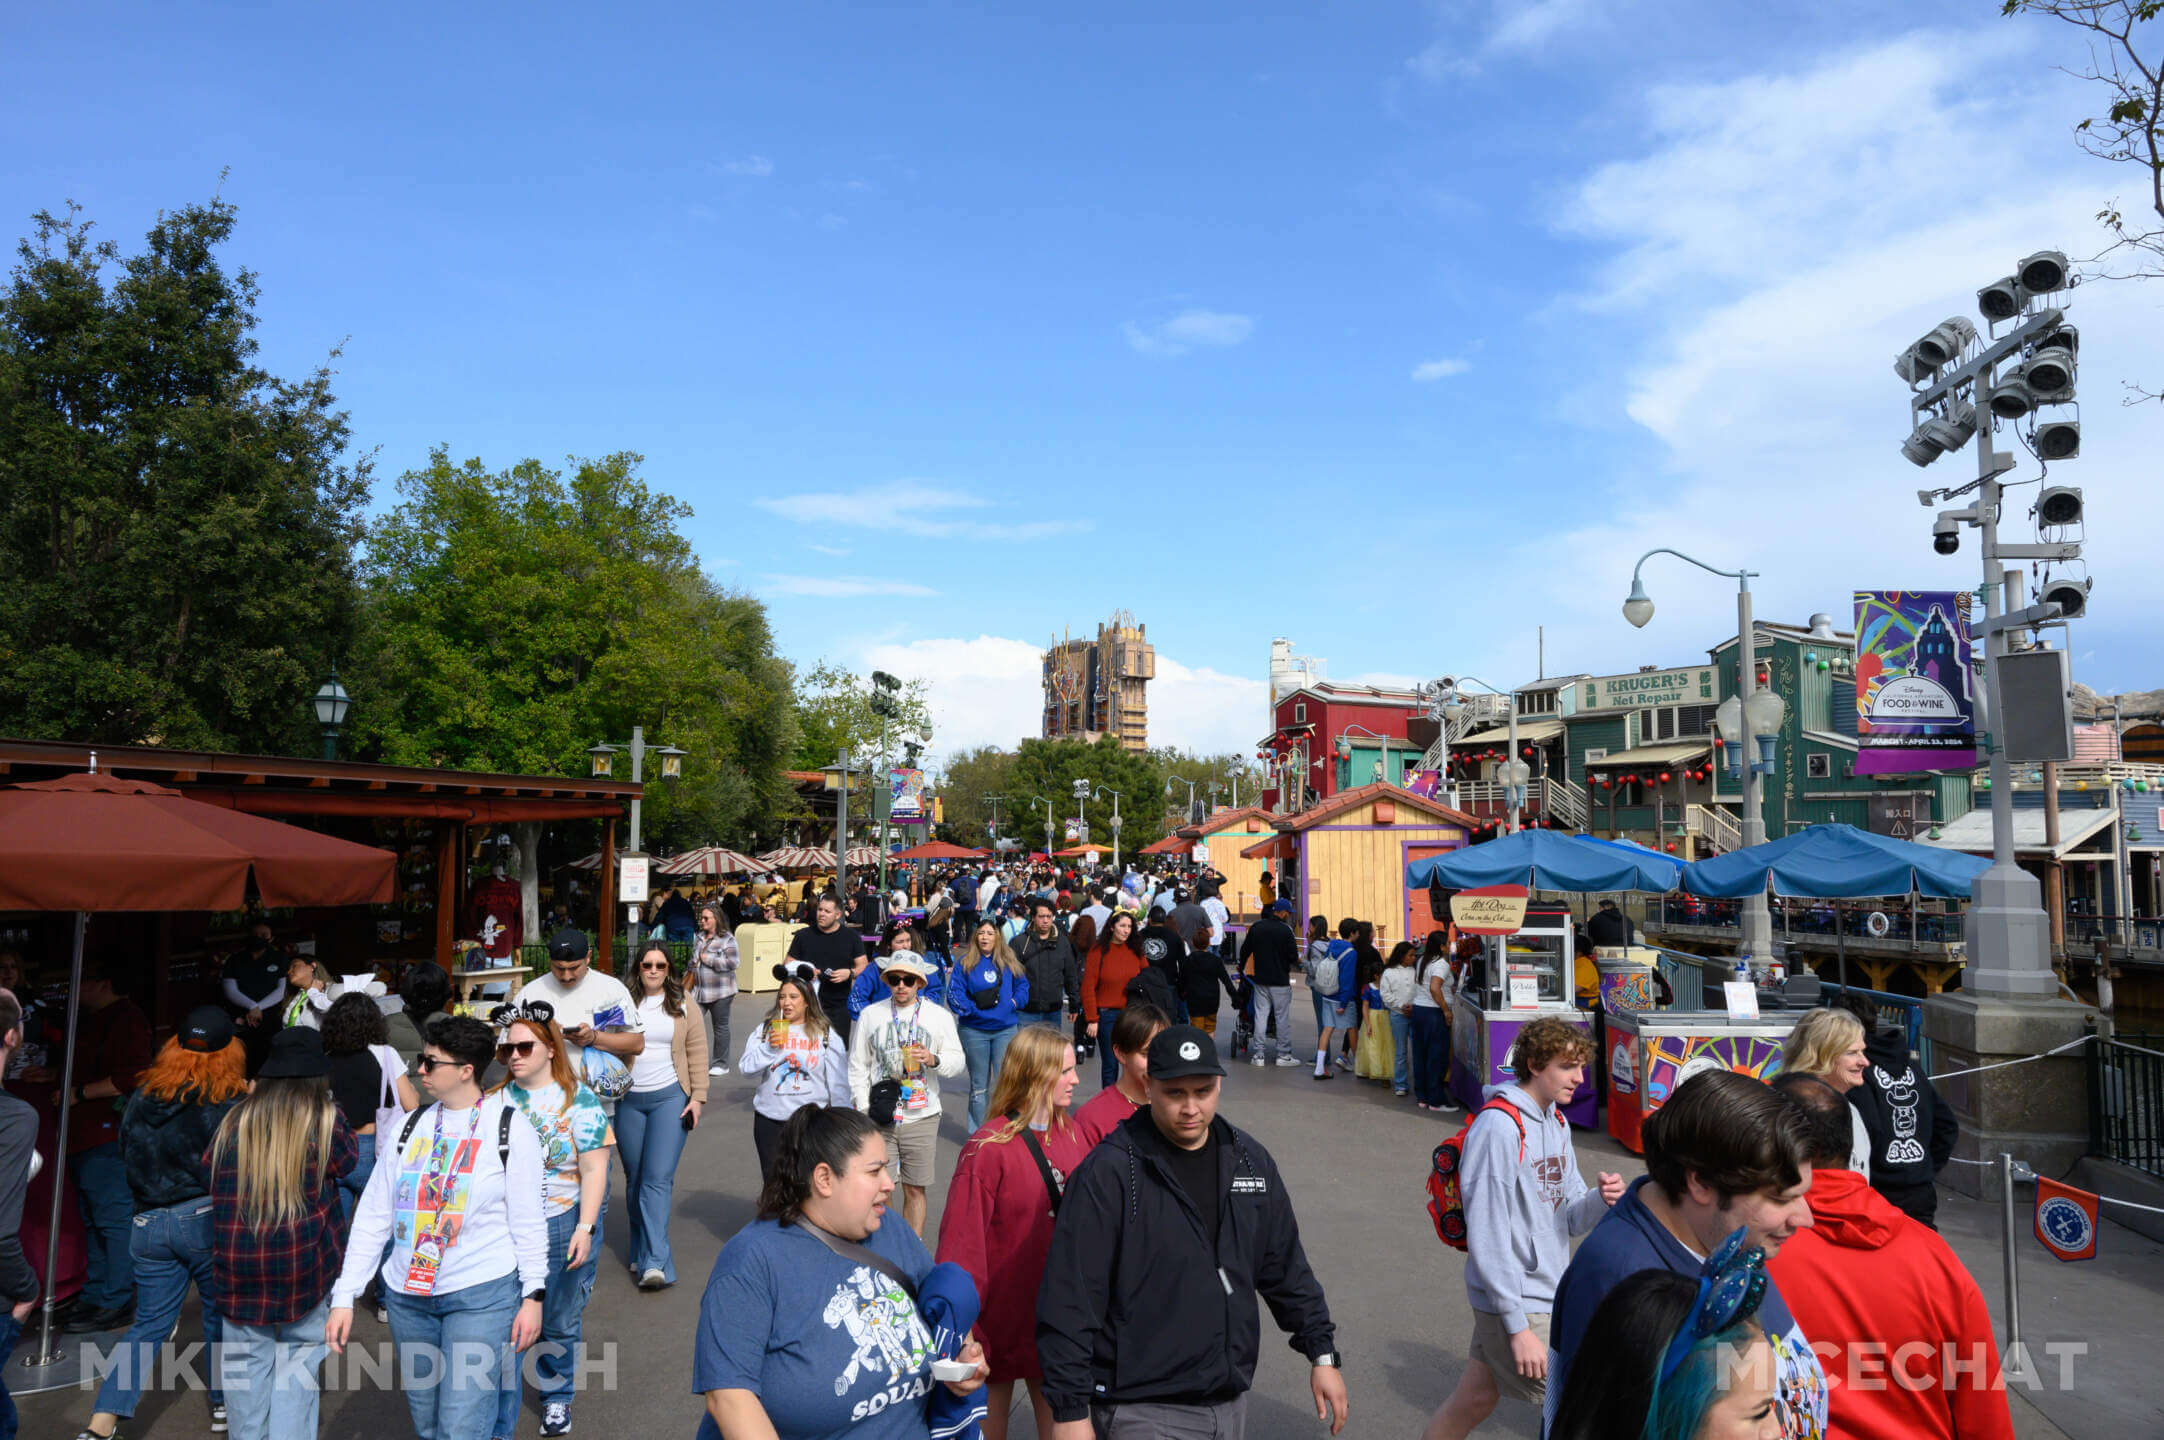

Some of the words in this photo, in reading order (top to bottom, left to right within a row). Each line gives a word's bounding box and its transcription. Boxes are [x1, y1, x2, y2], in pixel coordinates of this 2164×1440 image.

[1606, 673, 1689, 693] KRUGER'S
[1901, 685, 1924, 694] Disney
[1612, 695, 1634, 706] Net
[1637, 692, 1682, 705] Repair
[1882, 699, 1911, 708] FOOD
[1919, 699, 1945, 709] WINE
[1471, 898, 1484, 910] Hot
[1487, 898, 1506, 912] Dog
